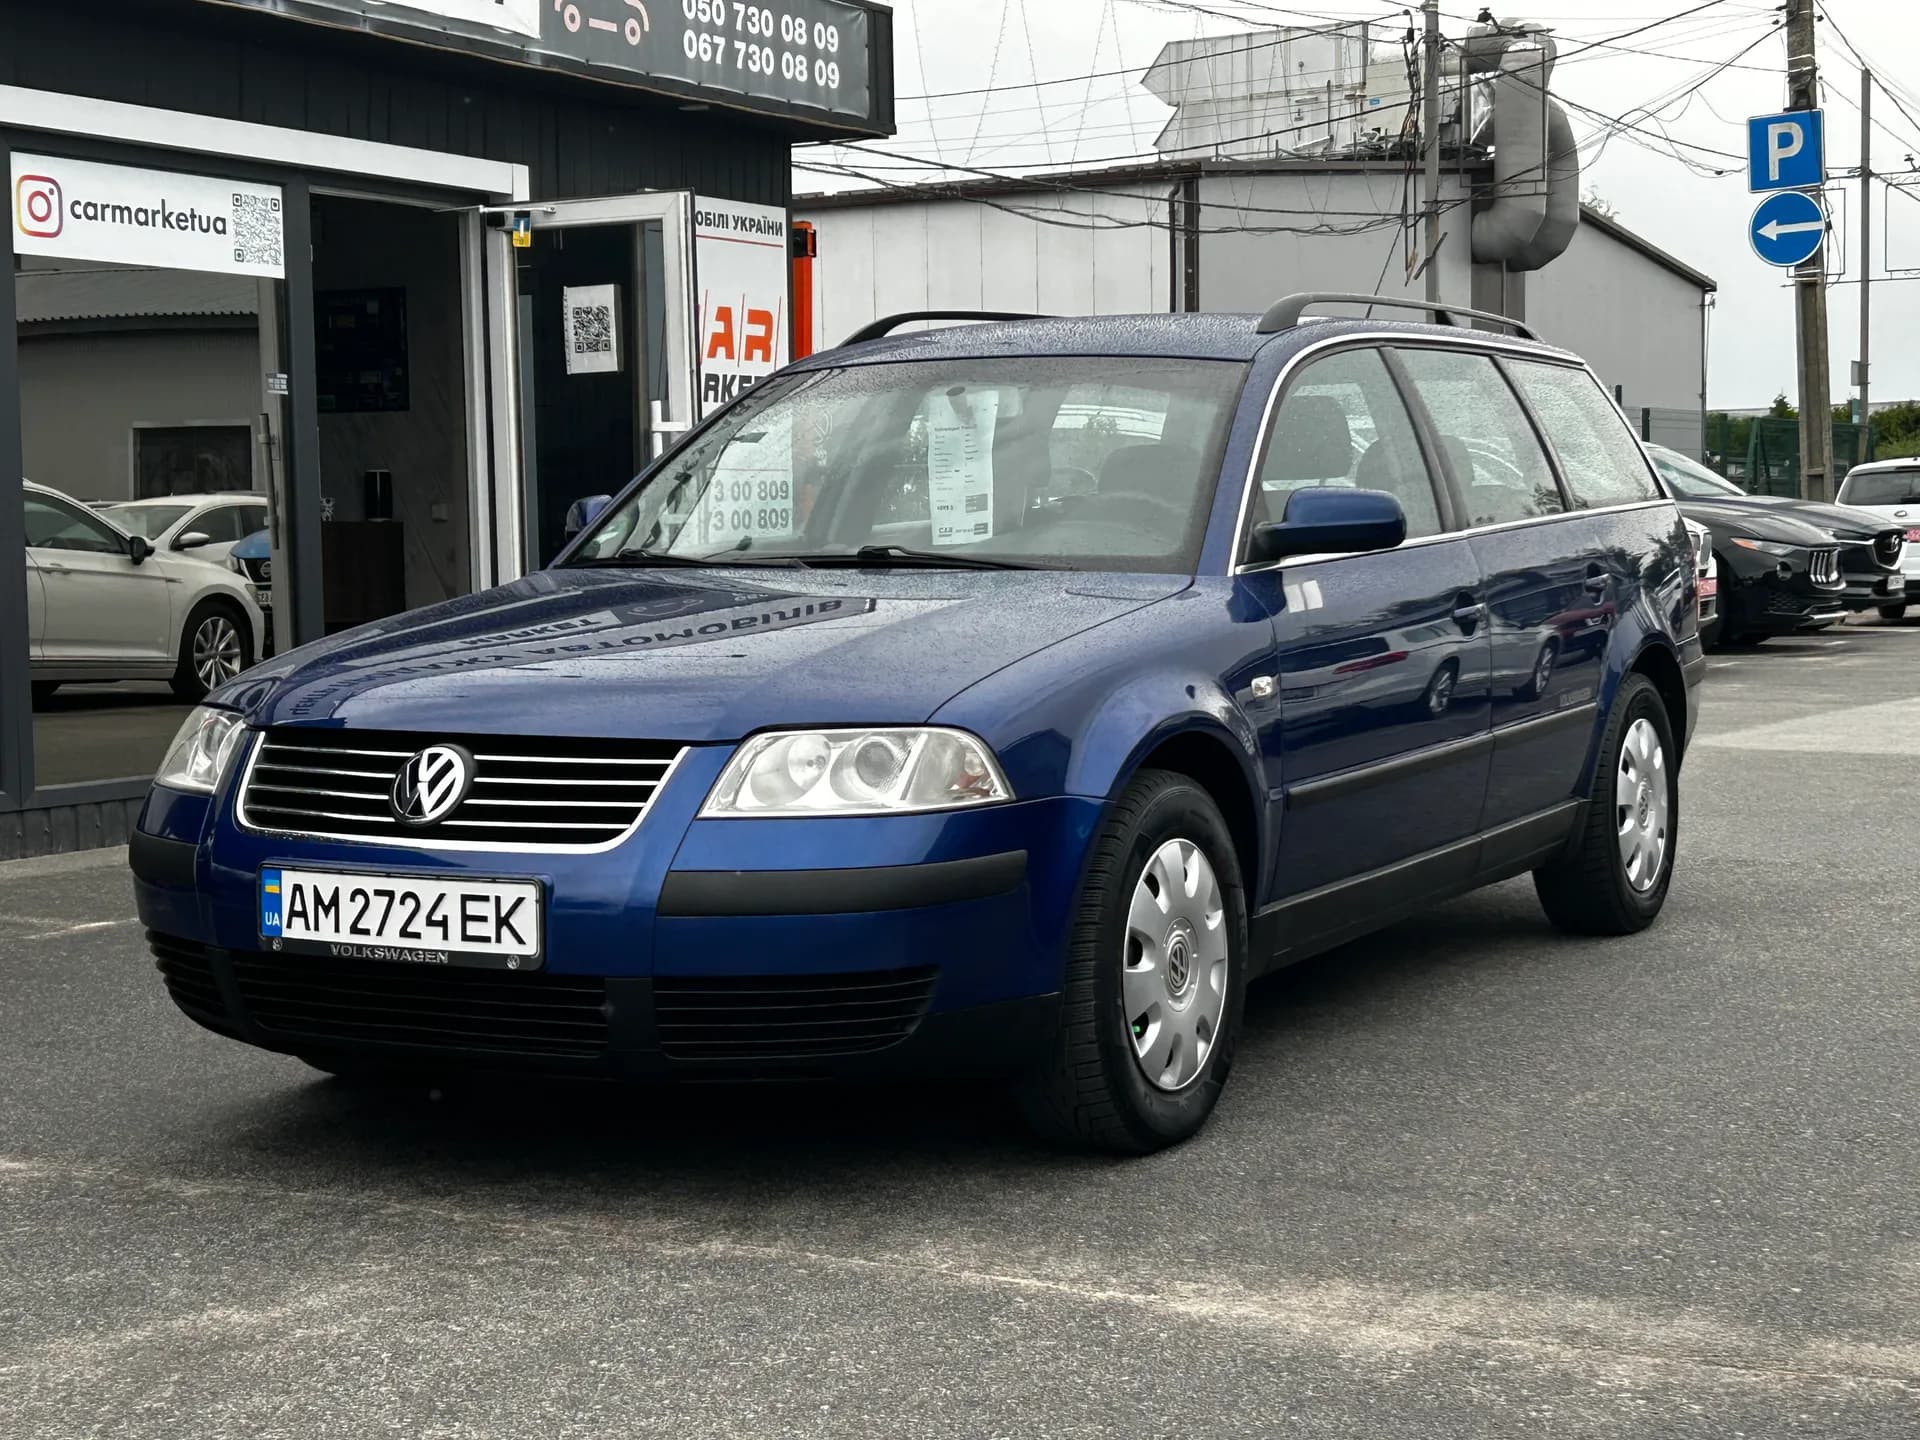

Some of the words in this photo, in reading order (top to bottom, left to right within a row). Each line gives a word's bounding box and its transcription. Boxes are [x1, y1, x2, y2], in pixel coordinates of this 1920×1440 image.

[682, 0, 726, 26] 050
[733, 2, 774, 38] 730
[781, 14, 808, 46] 08
[813, 22, 839, 53] 09
[683, 29, 726, 65] 067
[734, 40, 775, 76] 730
[781, 51, 808, 82] 08
[814, 59, 840, 89] 09
[1767, 121, 1804, 182] P
[70, 199, 227, 235] carmarketua
[732, 214, 783, 237] УКРАЇНИ
[731, 481, 752, 501] 00
[757, 480, 789, 501] 809
[731, 509, 752, 530] 00
[757, 508, 789, 529] 809
[265, 912, 280, 927] UA
[330, 943, 449, 964] VOLKSWAGEN
